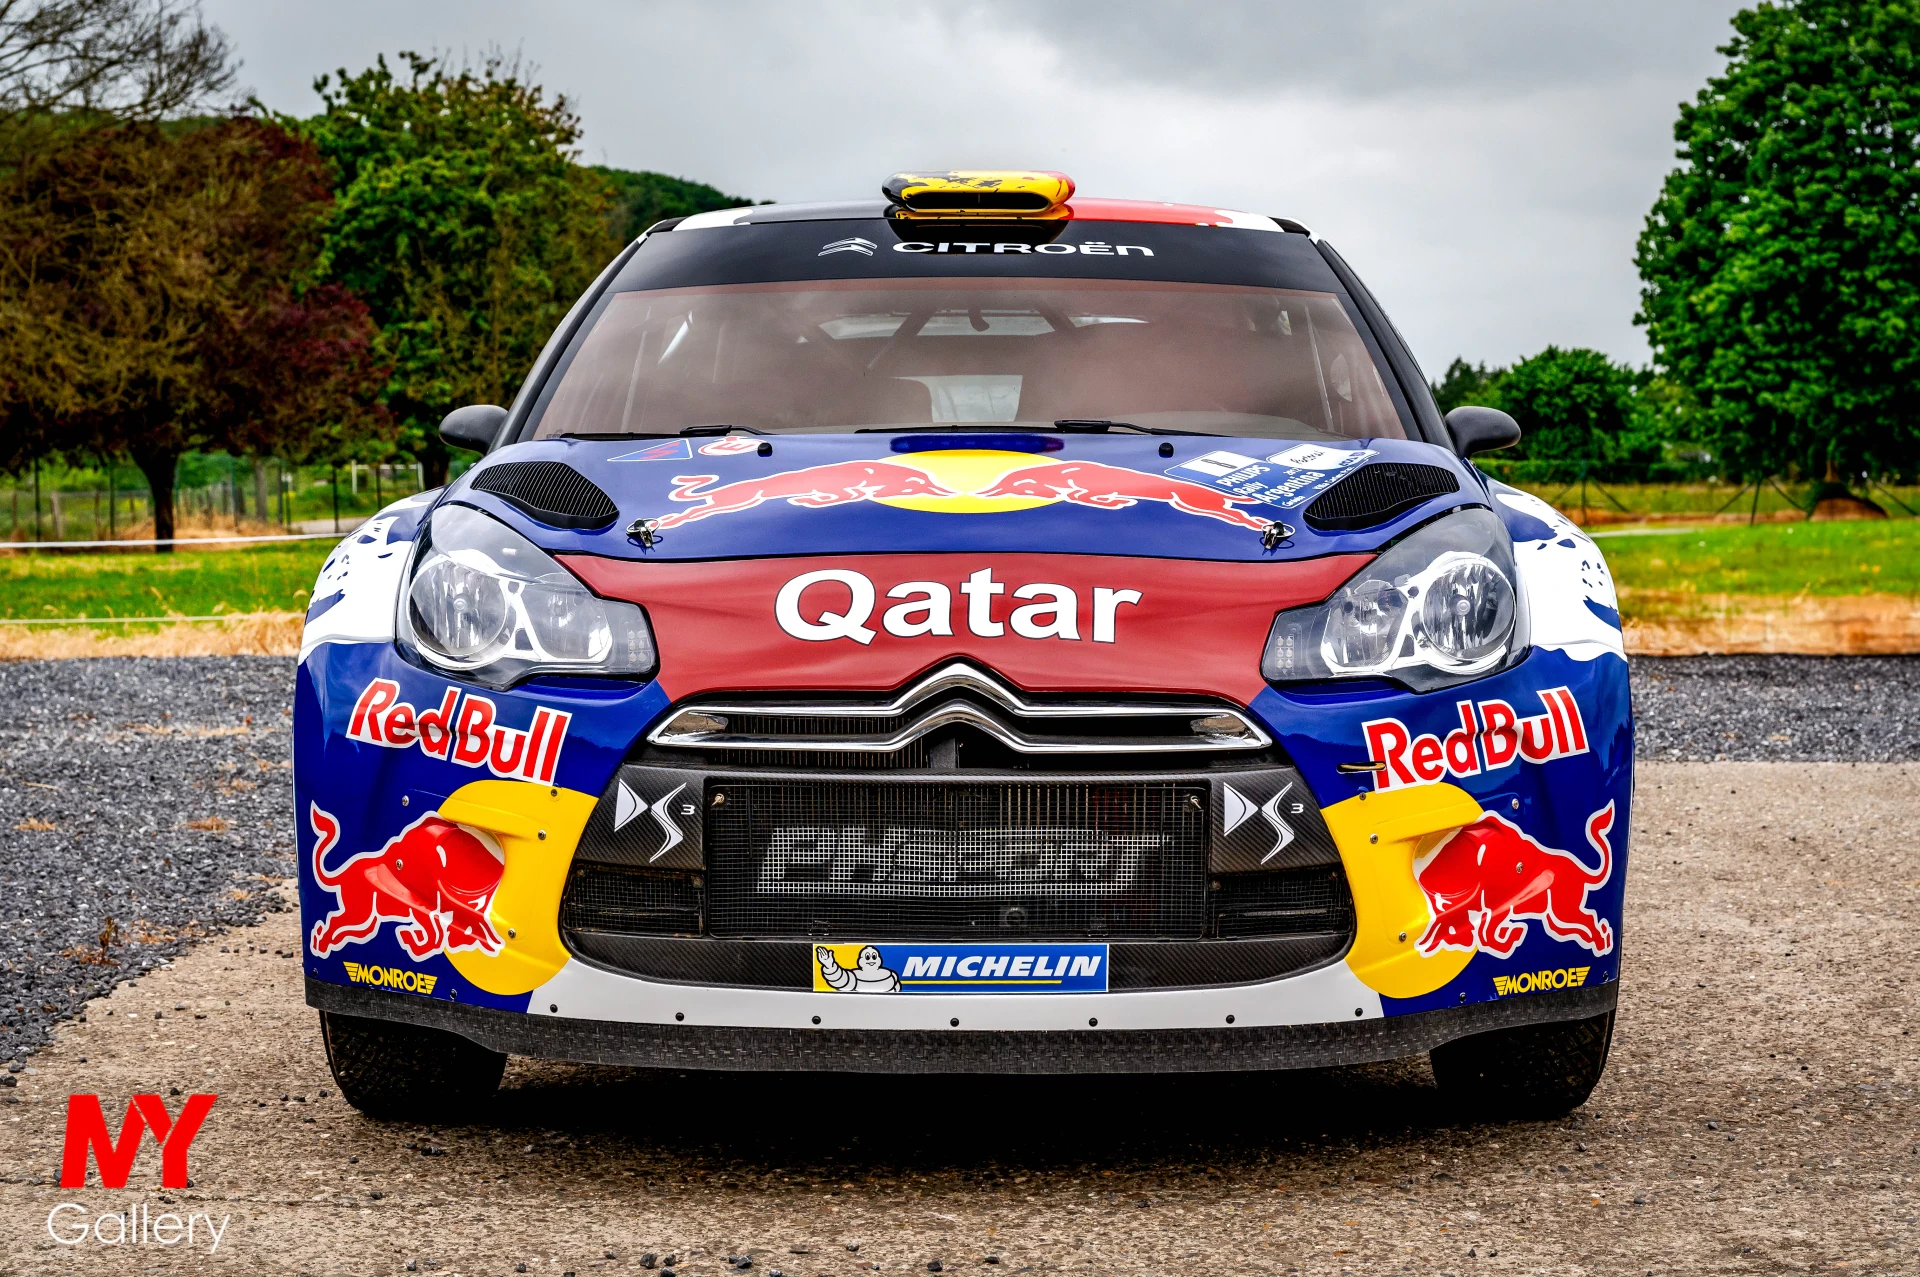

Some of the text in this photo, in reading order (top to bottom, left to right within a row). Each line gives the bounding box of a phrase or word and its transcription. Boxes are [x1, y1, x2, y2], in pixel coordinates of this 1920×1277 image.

[892, 241, 1155, 257] CITROËN
[1215, 464, 1271, 487] PHILIPS
[1251, 471, 1326, 503] Argentina
[1232, 481, 1269, 497] Rally
[774, 567, 1143, 646] Qatar
[355, 963, 428, 994] MONROE
[901, 956, 1101, 977] MICHELIN
[1503, 967, 1578, 996] MONROE
